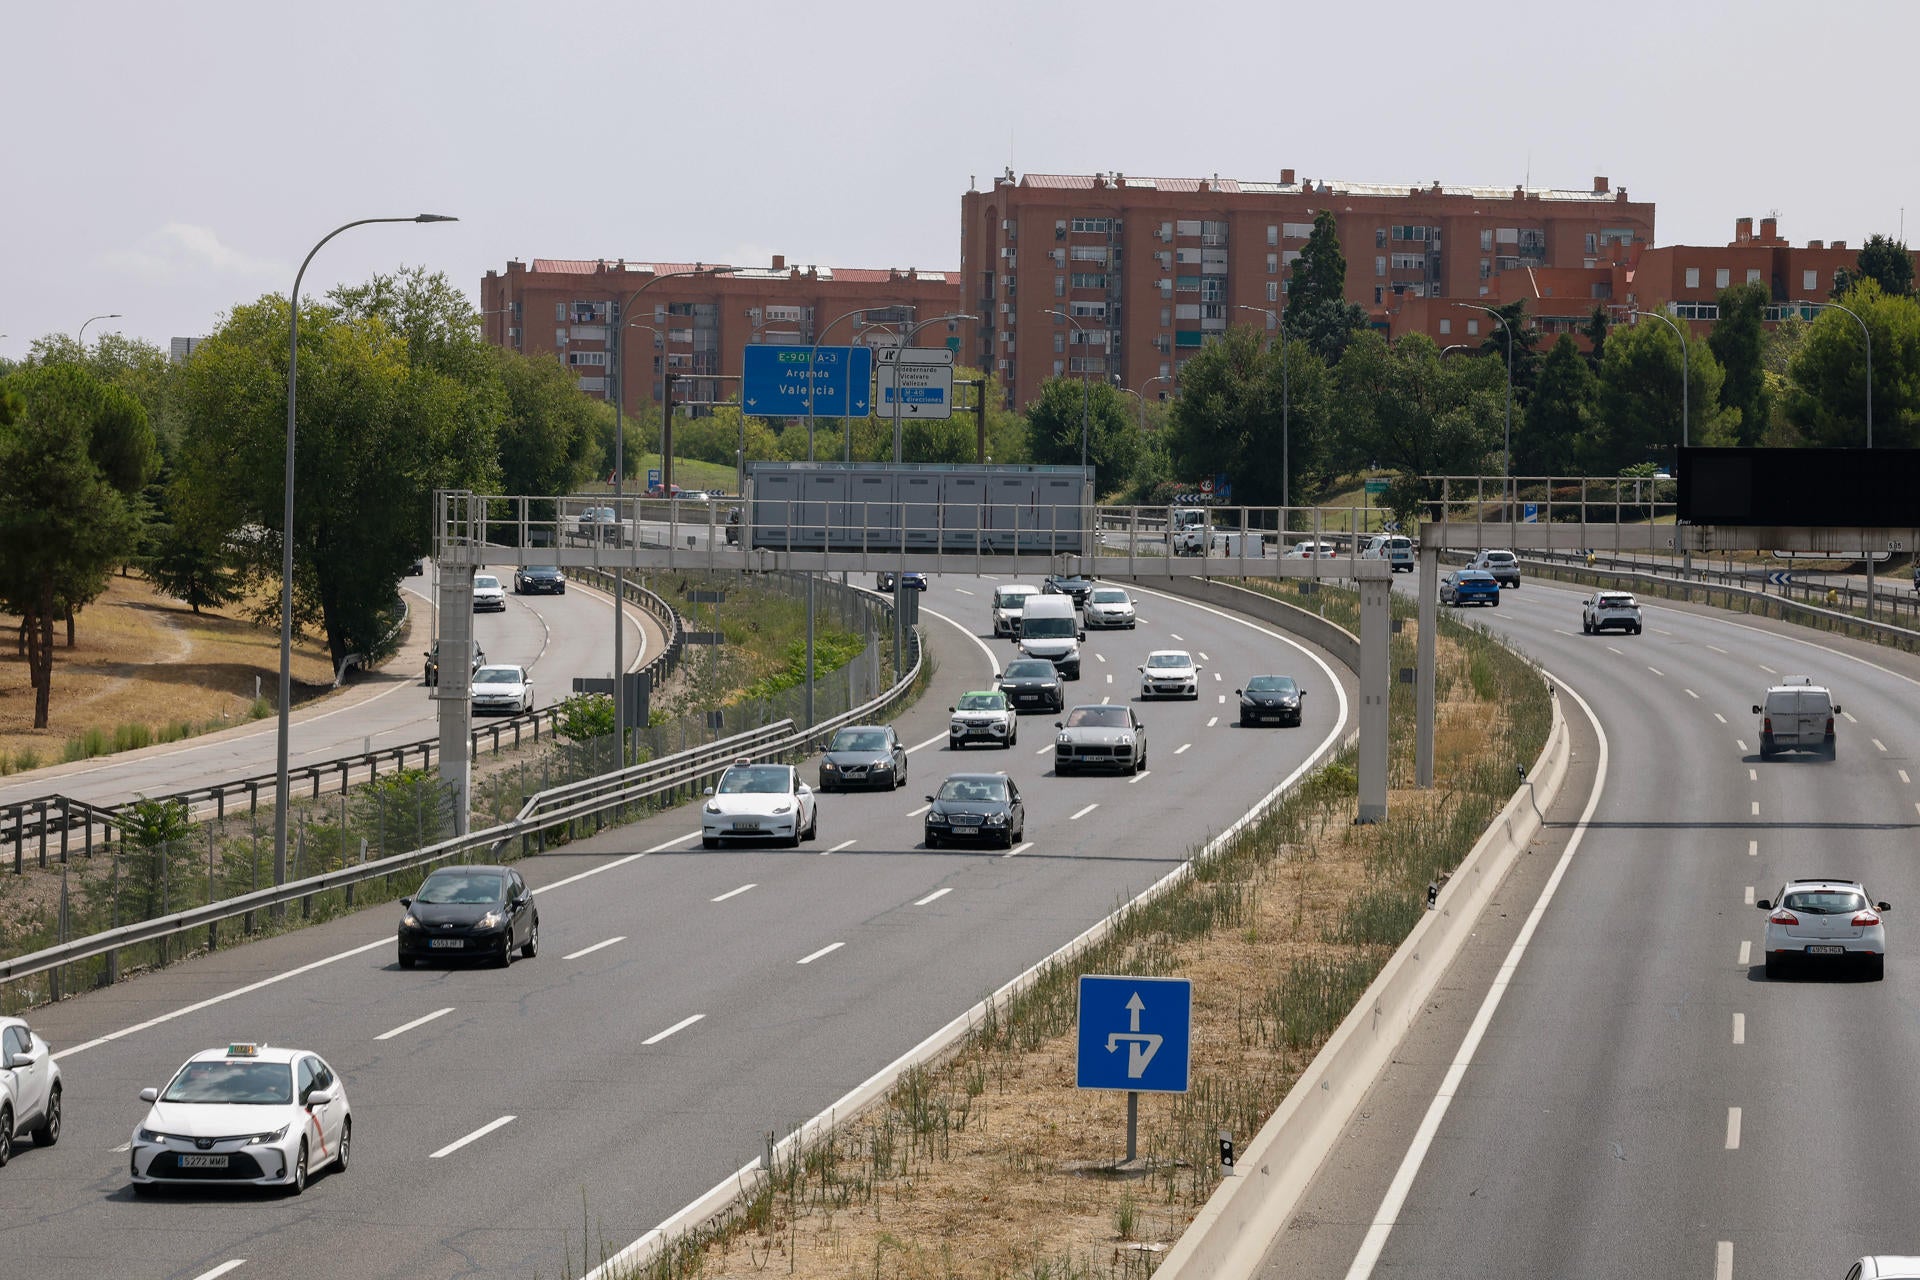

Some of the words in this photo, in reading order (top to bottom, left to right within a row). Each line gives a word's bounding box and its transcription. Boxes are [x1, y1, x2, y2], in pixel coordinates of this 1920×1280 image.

[779, 353, 810, 362] E-901
[817, 353, 836, 362] A-3
[786, 368, 830, 380] Arganda
[184, 1156, 207, 1166] 5272
